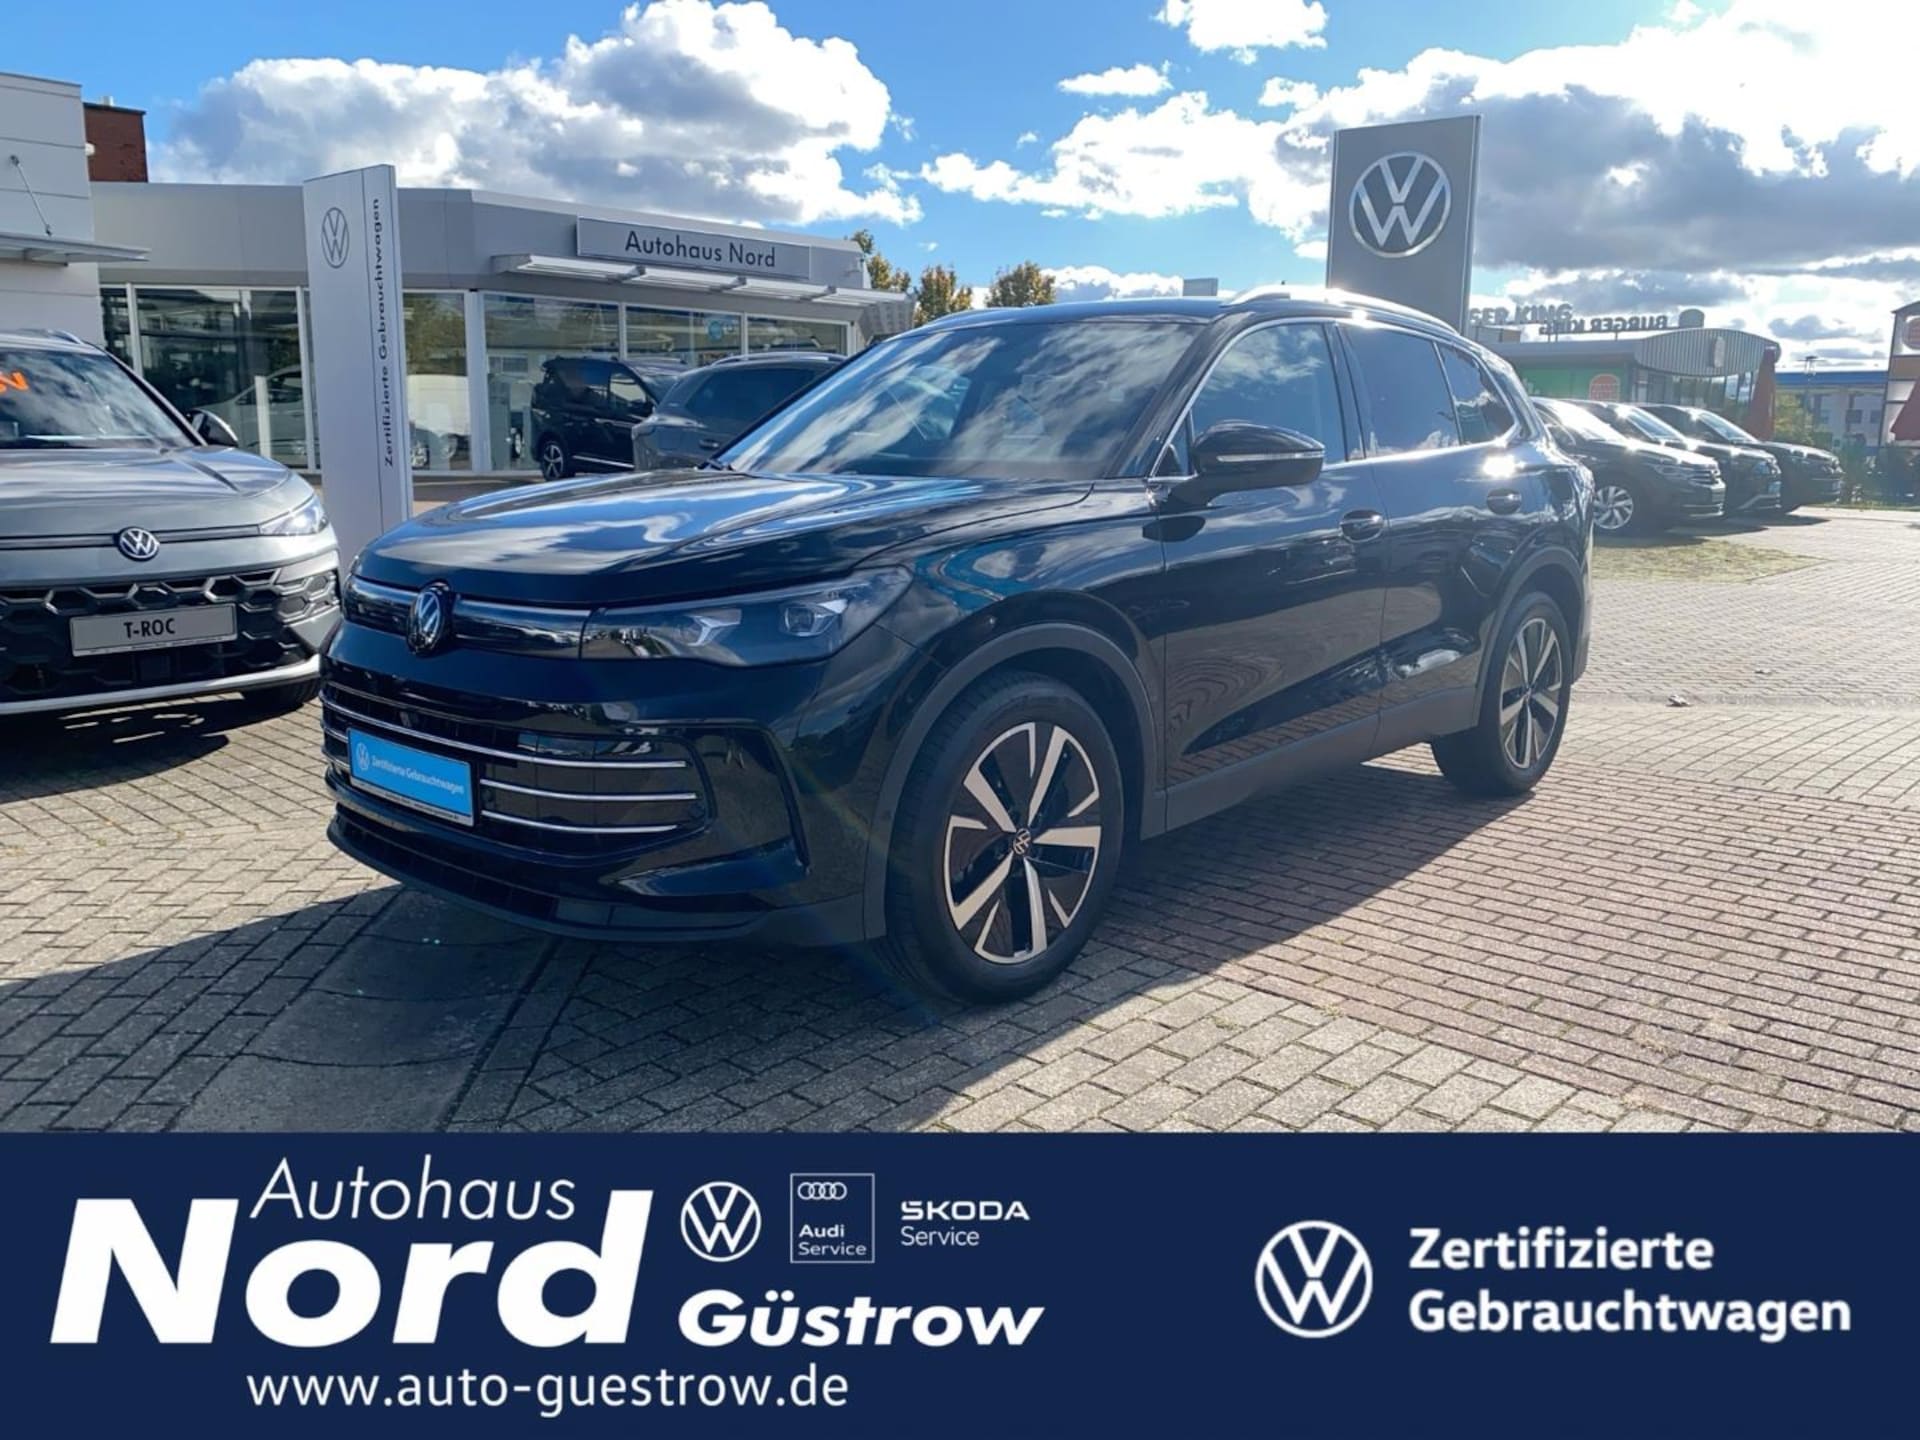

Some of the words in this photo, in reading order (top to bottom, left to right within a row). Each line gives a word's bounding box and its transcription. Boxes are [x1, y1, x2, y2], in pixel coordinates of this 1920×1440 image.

[625, 230, 722, 262] Autohaus
[729, 242, 776, 268] Nord
[372, 198, 388, 360] Gebrauchtwagen
[377, 366, 394, 467] Zertifizierte
[123, 618, 176, 639] T-ROC
[405, 767, 465, 795] Gebrauchtwagen
